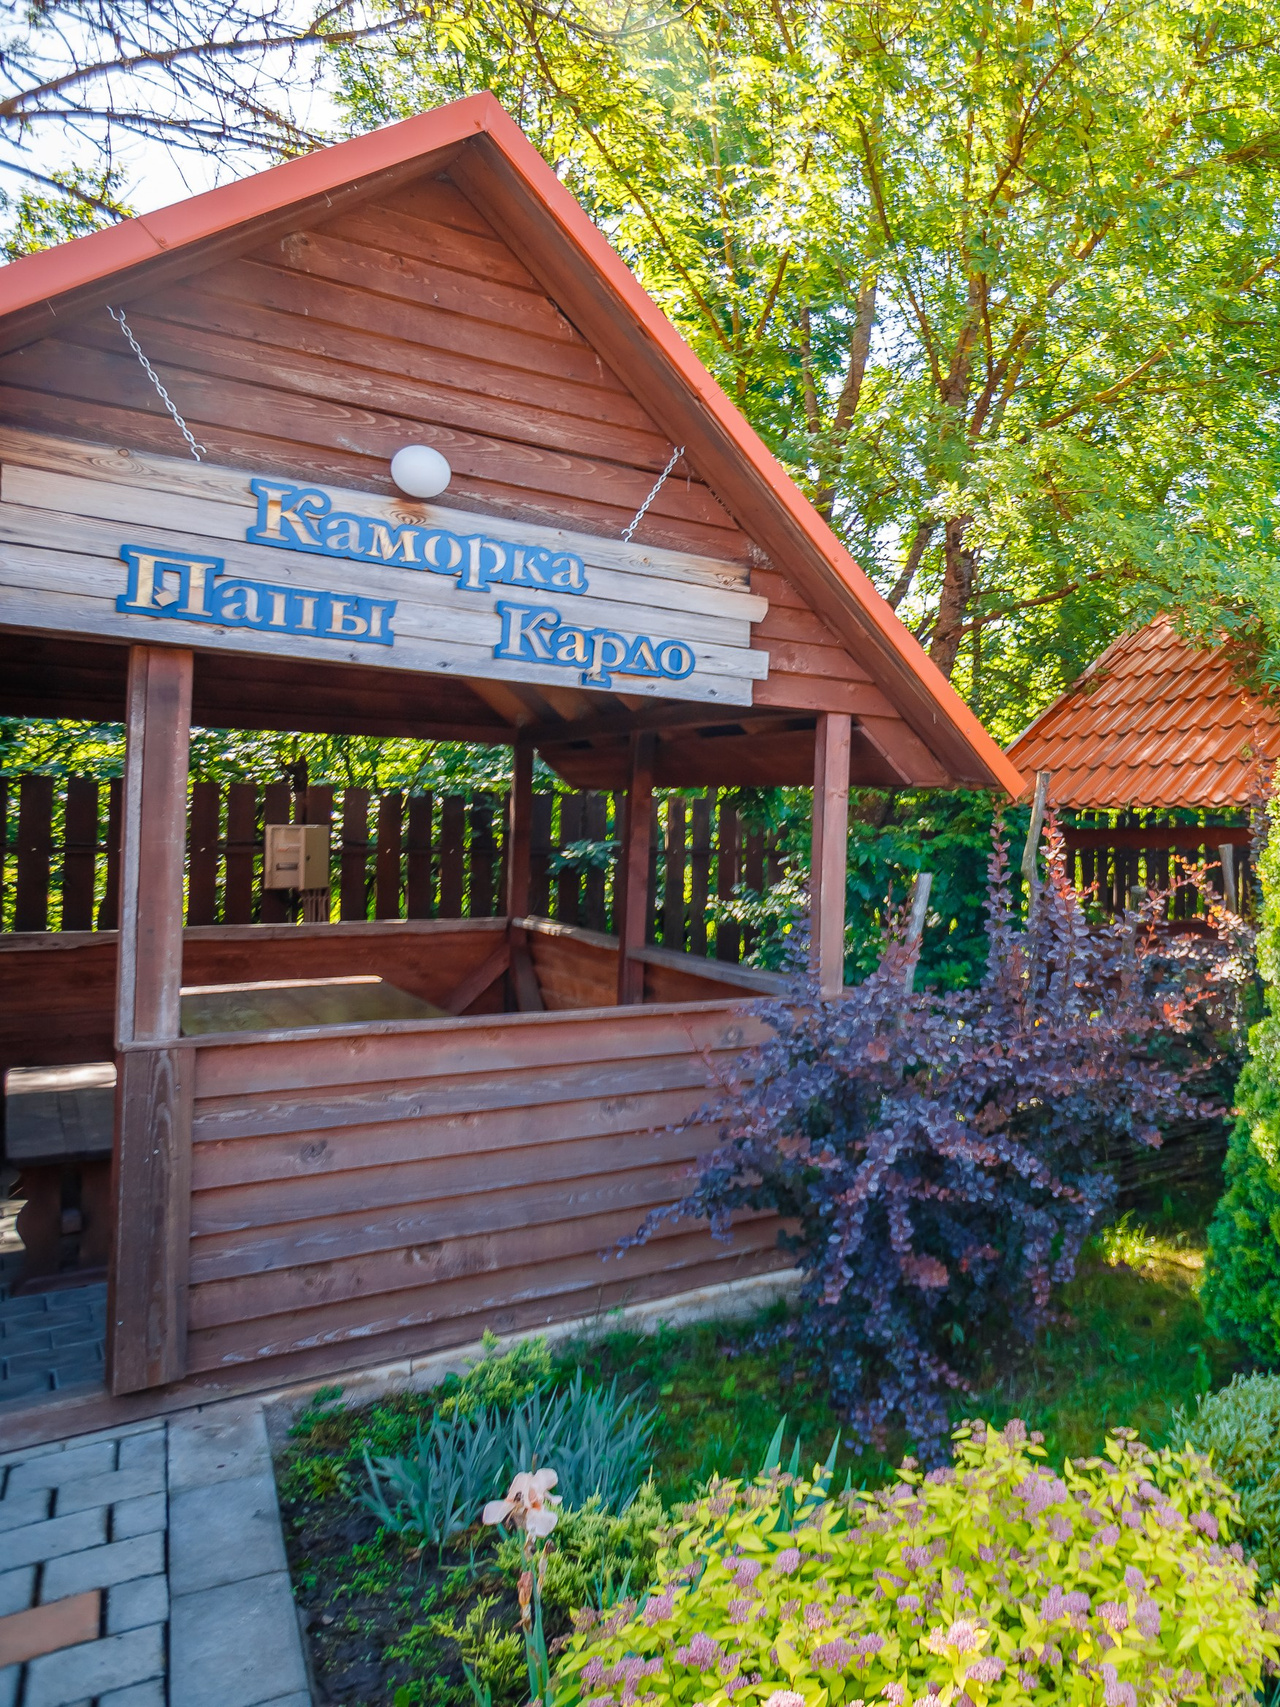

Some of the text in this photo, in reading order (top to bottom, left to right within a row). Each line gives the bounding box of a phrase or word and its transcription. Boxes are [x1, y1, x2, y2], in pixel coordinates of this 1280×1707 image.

[254, 484, 586, 591] Каморка
[124, 549, 693, 684] Папы Карло
